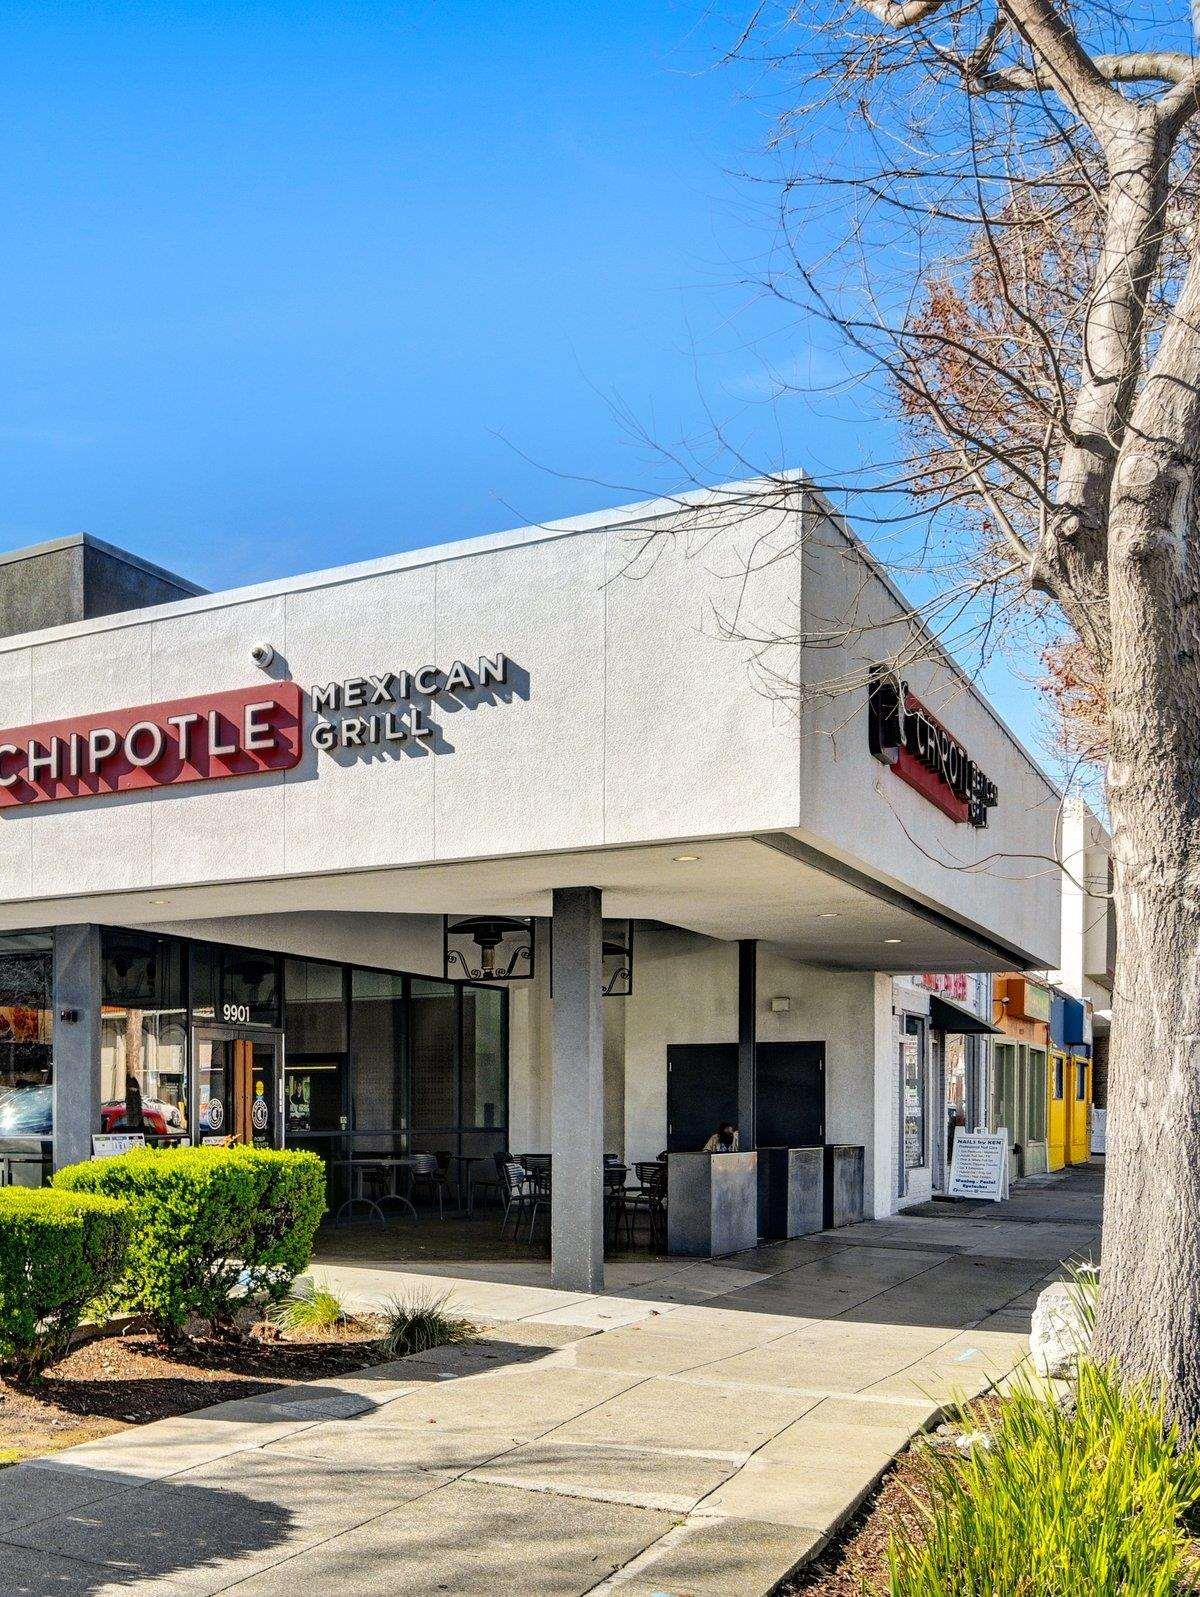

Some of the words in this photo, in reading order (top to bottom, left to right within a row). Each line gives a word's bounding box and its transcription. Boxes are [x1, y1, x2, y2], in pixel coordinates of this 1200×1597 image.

[310, 652, 506, 712] MEXICAN
[310, 707, 432, 751] GRILL
[223, 1003, 250, 1022] 9901
